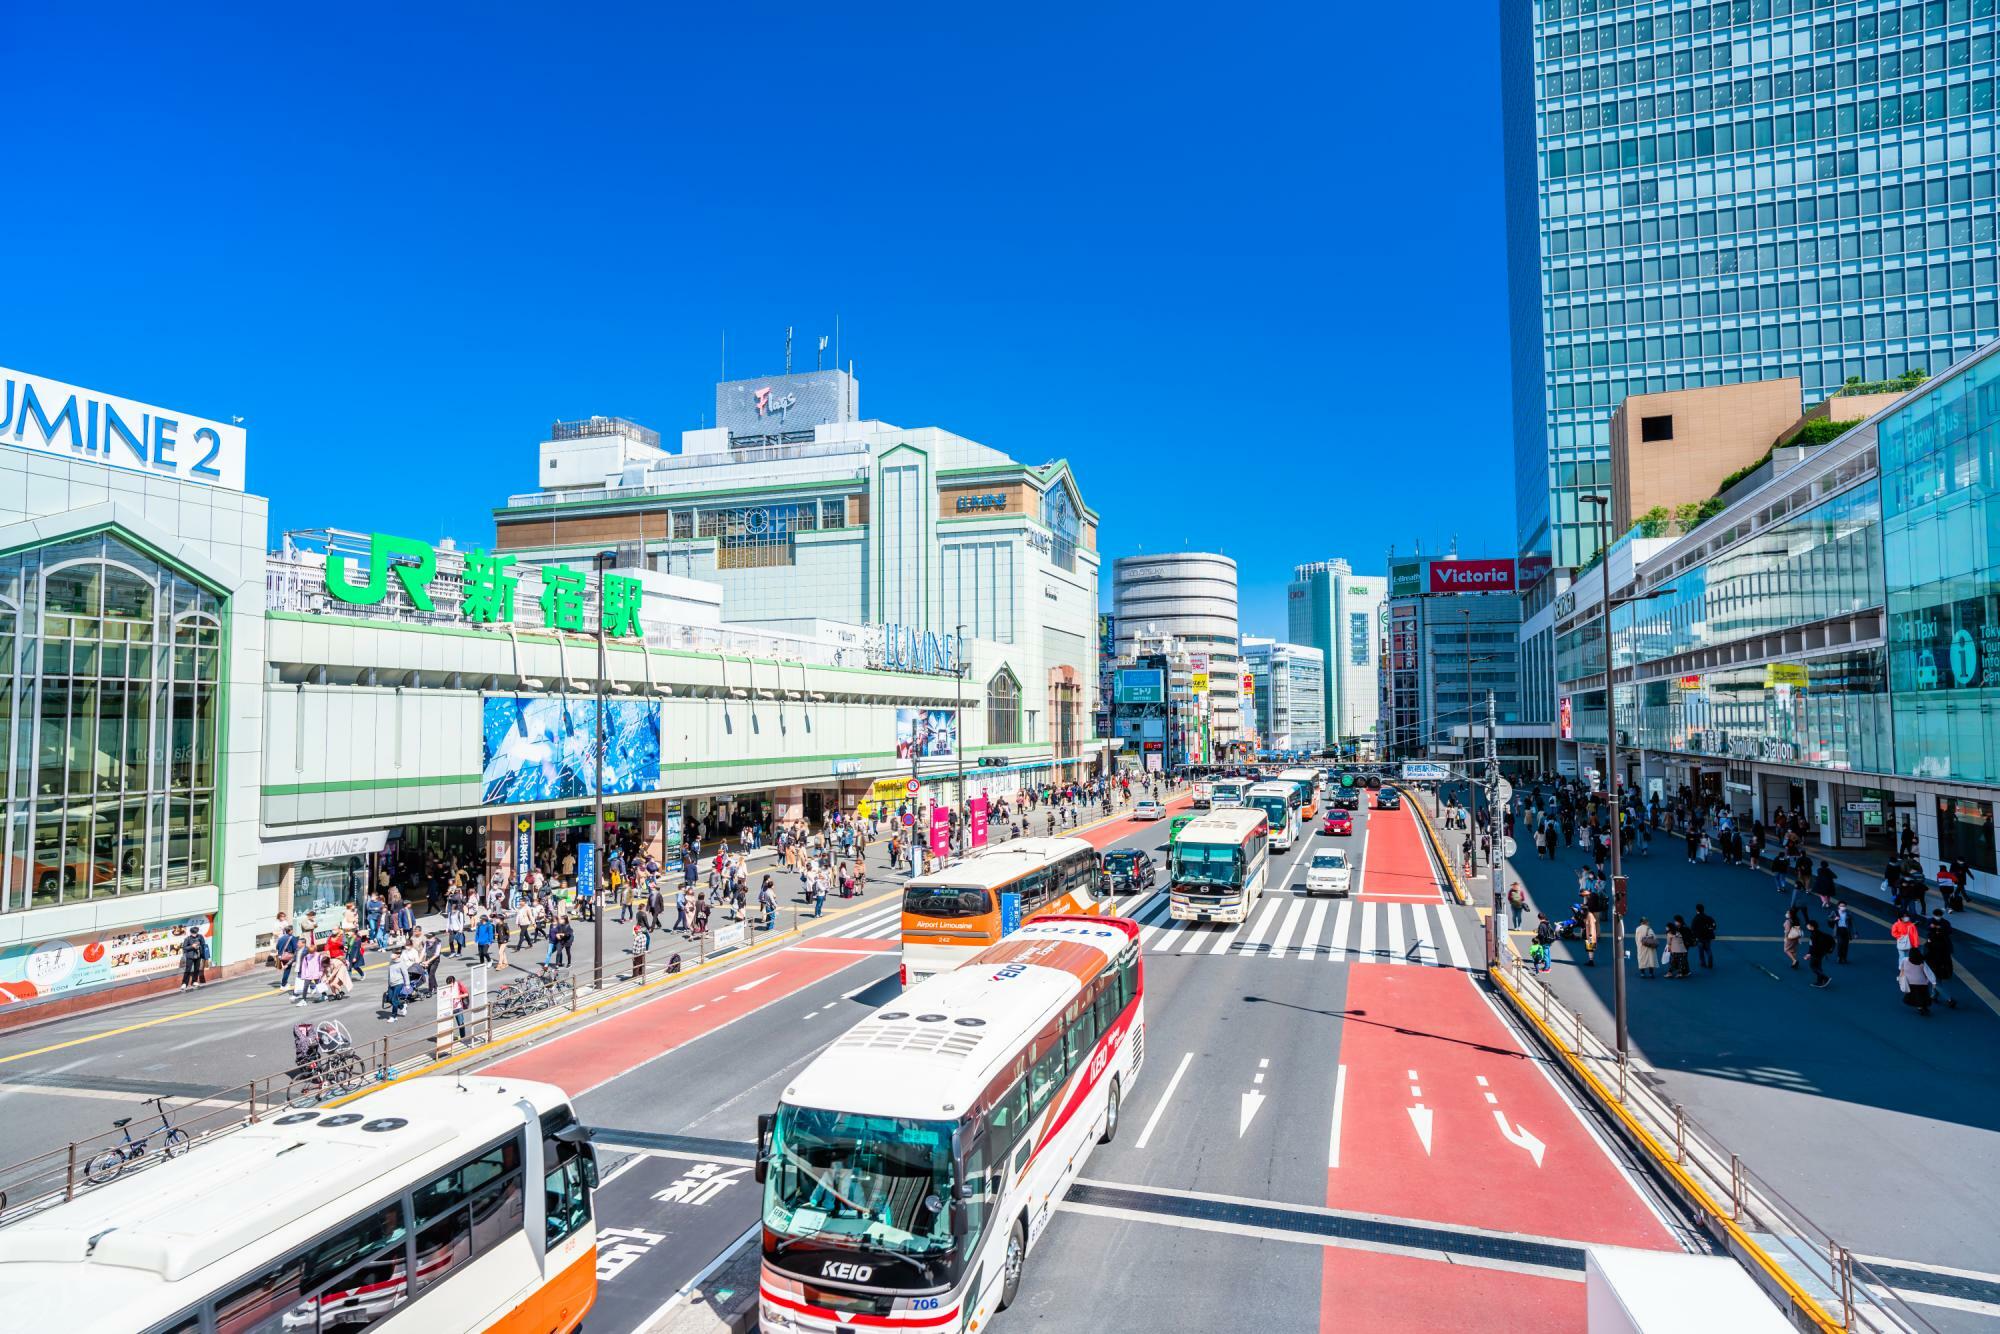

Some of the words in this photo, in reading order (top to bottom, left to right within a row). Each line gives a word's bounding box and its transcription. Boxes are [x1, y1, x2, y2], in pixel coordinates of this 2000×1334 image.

[754, 387, 796, 420] Flags
[192, 427, 221, 476] 2
[326, 532, 436, 612] JR
[461, 547, 644, 638] 新宿駅
[1436, 568, 1508, 583] Victoria
[1915, 617, 1937, 641] Taxi
[885, 623, 953, 673] LUMINE
[1132, 687, 1152, 695] ニトリ
[1728, 735, 1758, 760] Shinjuku
[1763, 736, 1793, 761] Station
[306, 839, 360, 858] LUMINE
[360, 837, 369, 852] 2
[916, 921, 938, 929] Airport
[940, 921, 972, 929] Limousine
[1022, 927, 1112, 938] 61706
[988, 964, 1027, 981] KEIO
[1089, 1044, 1108, 1086] KEIO
[821, 1260, 873, 1283] KEIO
[912, 1297, 939, 1311] 706
